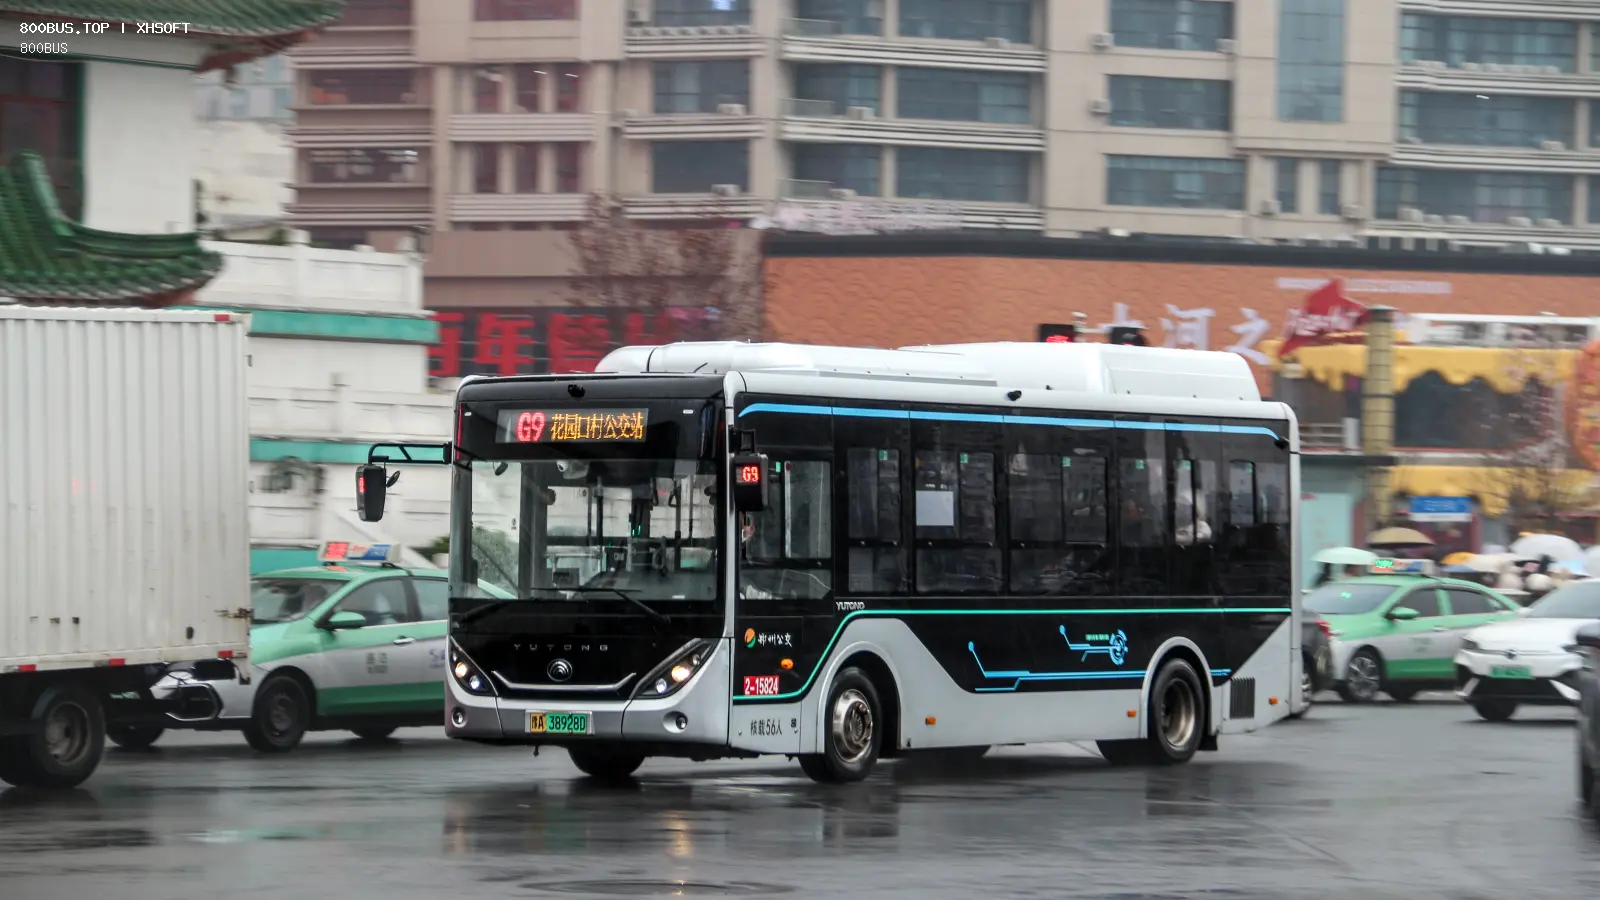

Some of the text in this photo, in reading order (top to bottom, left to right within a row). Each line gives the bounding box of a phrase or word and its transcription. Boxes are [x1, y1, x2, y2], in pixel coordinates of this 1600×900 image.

[516, 412, 645, 442] G9 花园口村公交站
[742, 466, 759, 482] G9
[513, 643, 608, 651] YUTONG
[744, 677, 779, 695] 2-15824
